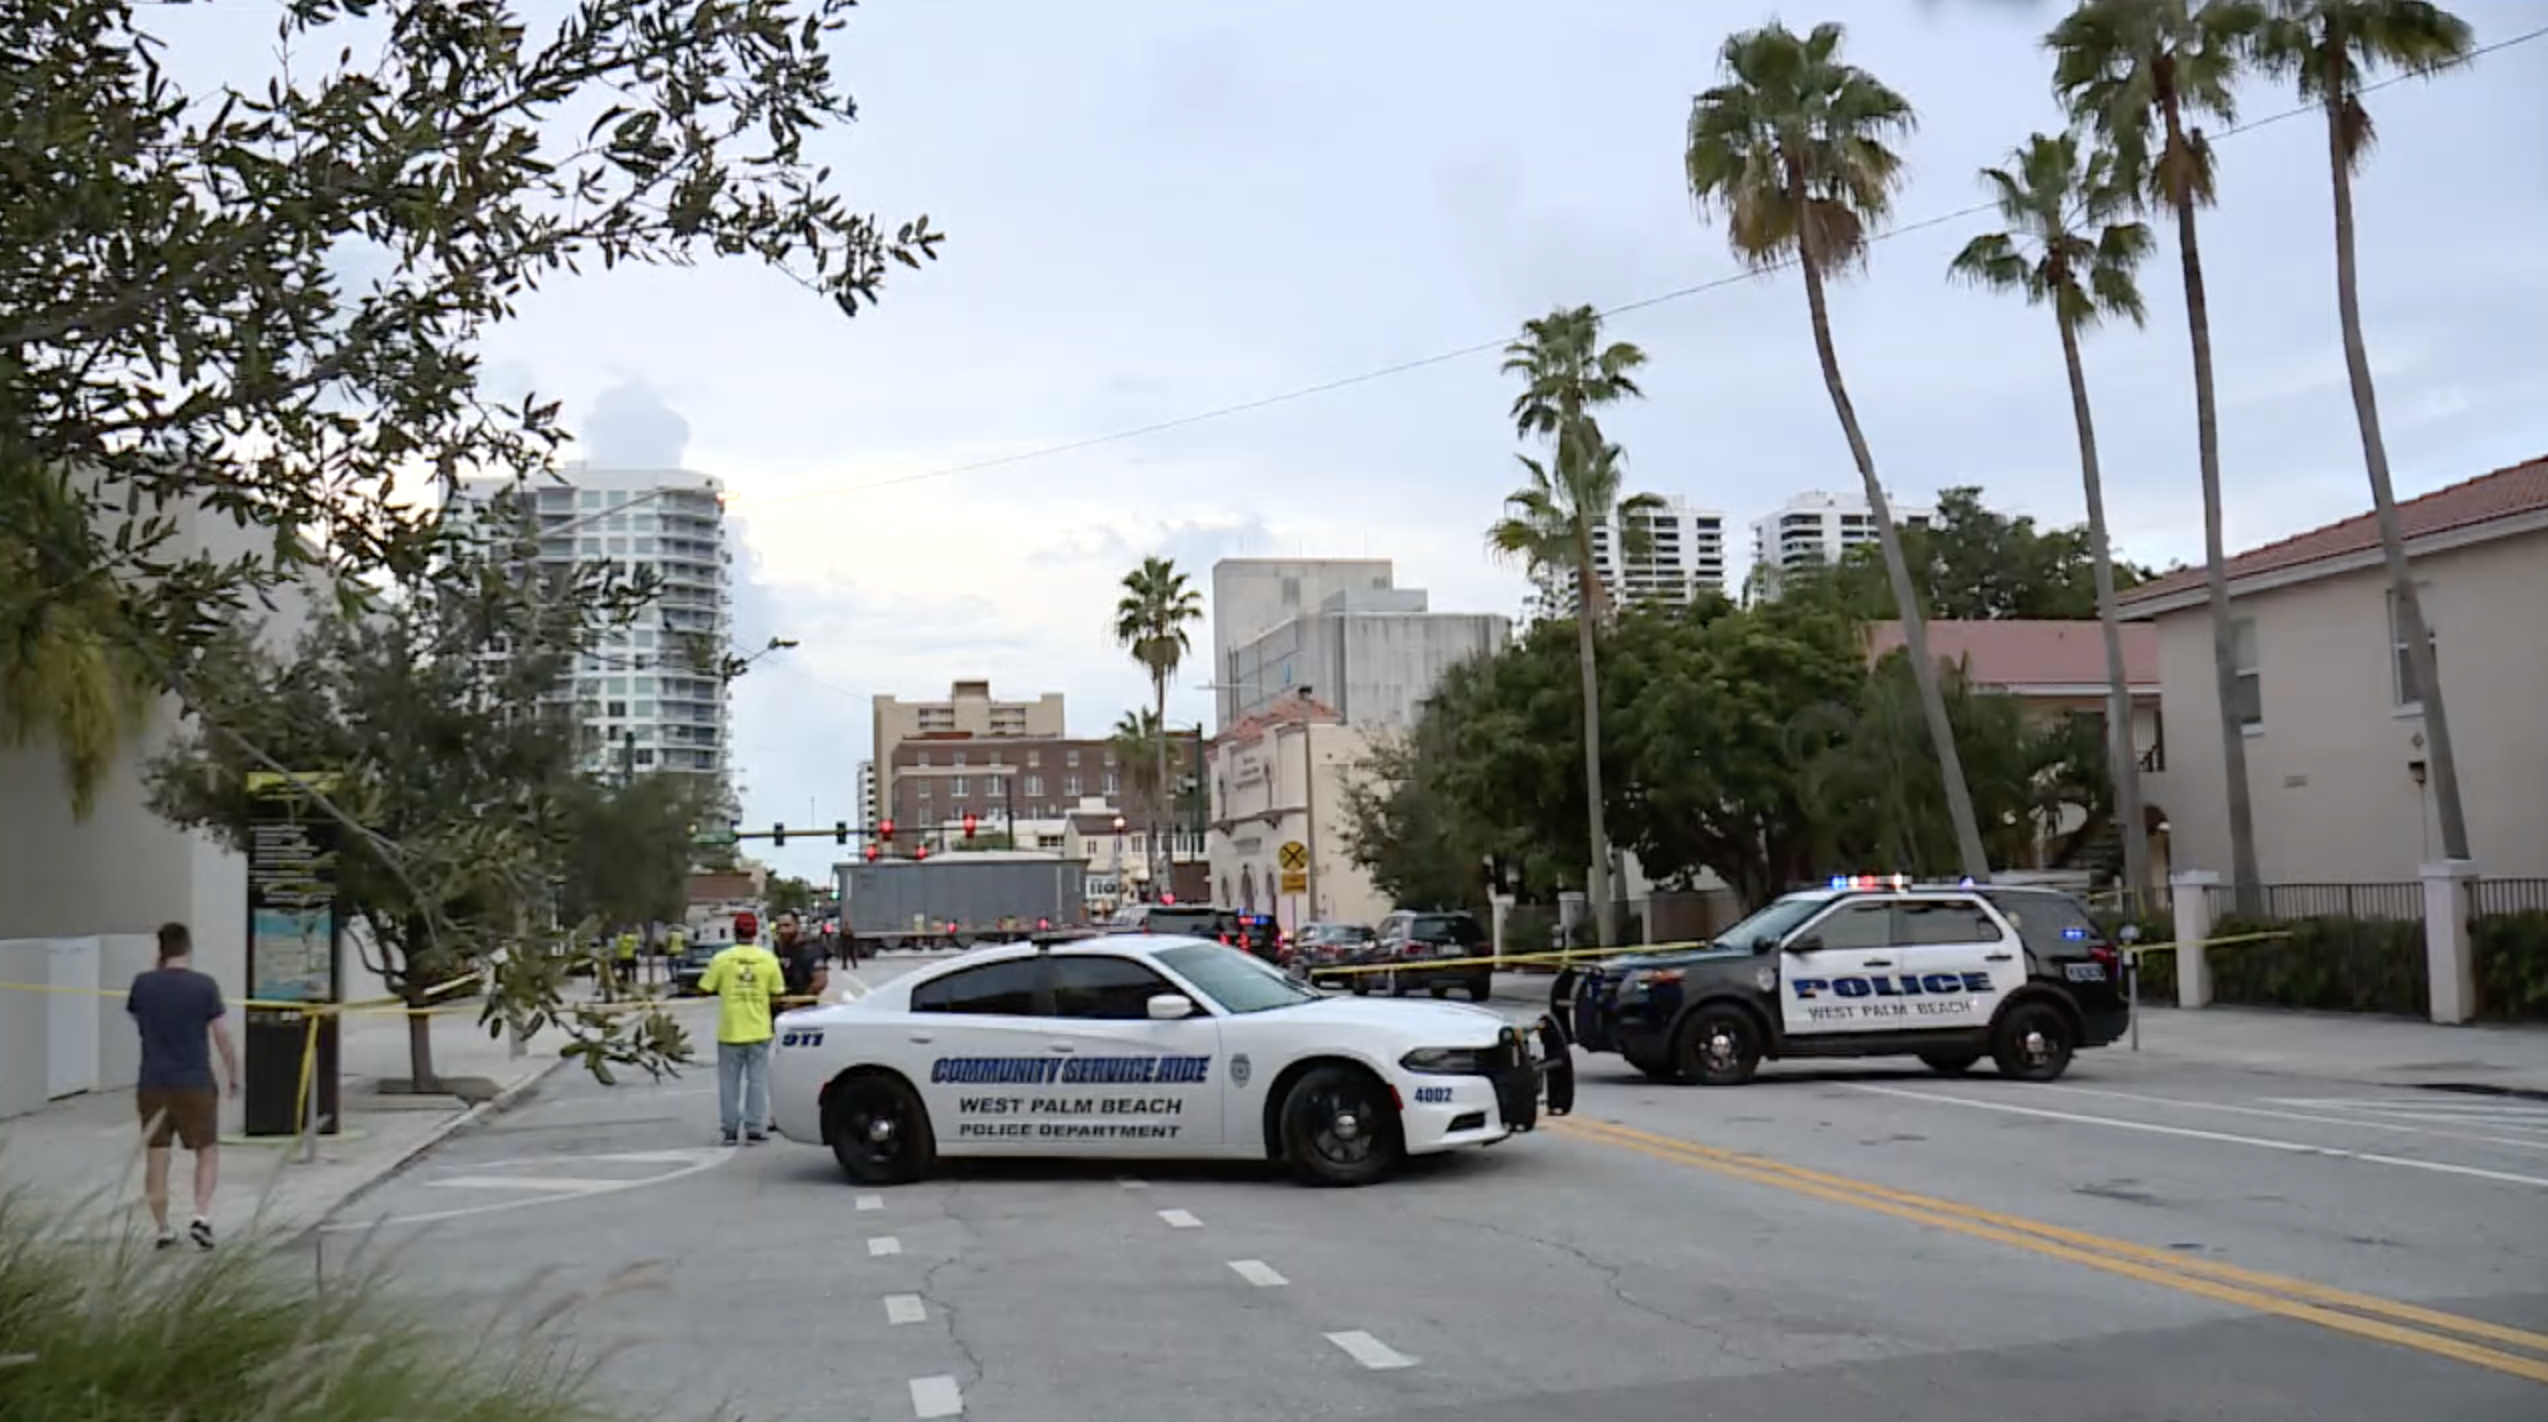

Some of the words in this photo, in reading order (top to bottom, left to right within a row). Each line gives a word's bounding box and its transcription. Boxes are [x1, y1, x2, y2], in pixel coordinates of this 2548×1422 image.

[1792, 972, 1996, 998] POLICE
[1807, 1005, 1854, 1021] WEST
[1862, 1003, 1909, 1018] PALM
[1918, 1001, 1972, 1015] BEACH
[782, 1032, 824, 1047] 911
[931, 1057, 1063, 1084] COMMUNITY
[1061, 1056, 1158, 1084] SERVICE
[1155, 1055, 1212, 1084] AIDE
[1414, 1087, 1453, 1102] 4002
[959, 1097, 1024, 1114] WEST
[1030, 1098, 1093, 1114] PALM
[1100, 1098, 1183, 1115] BEACH
[959, 1123, 1033, 1137] POLICE
[1039, 1124, 1182, 1139] DEPARTMENT
